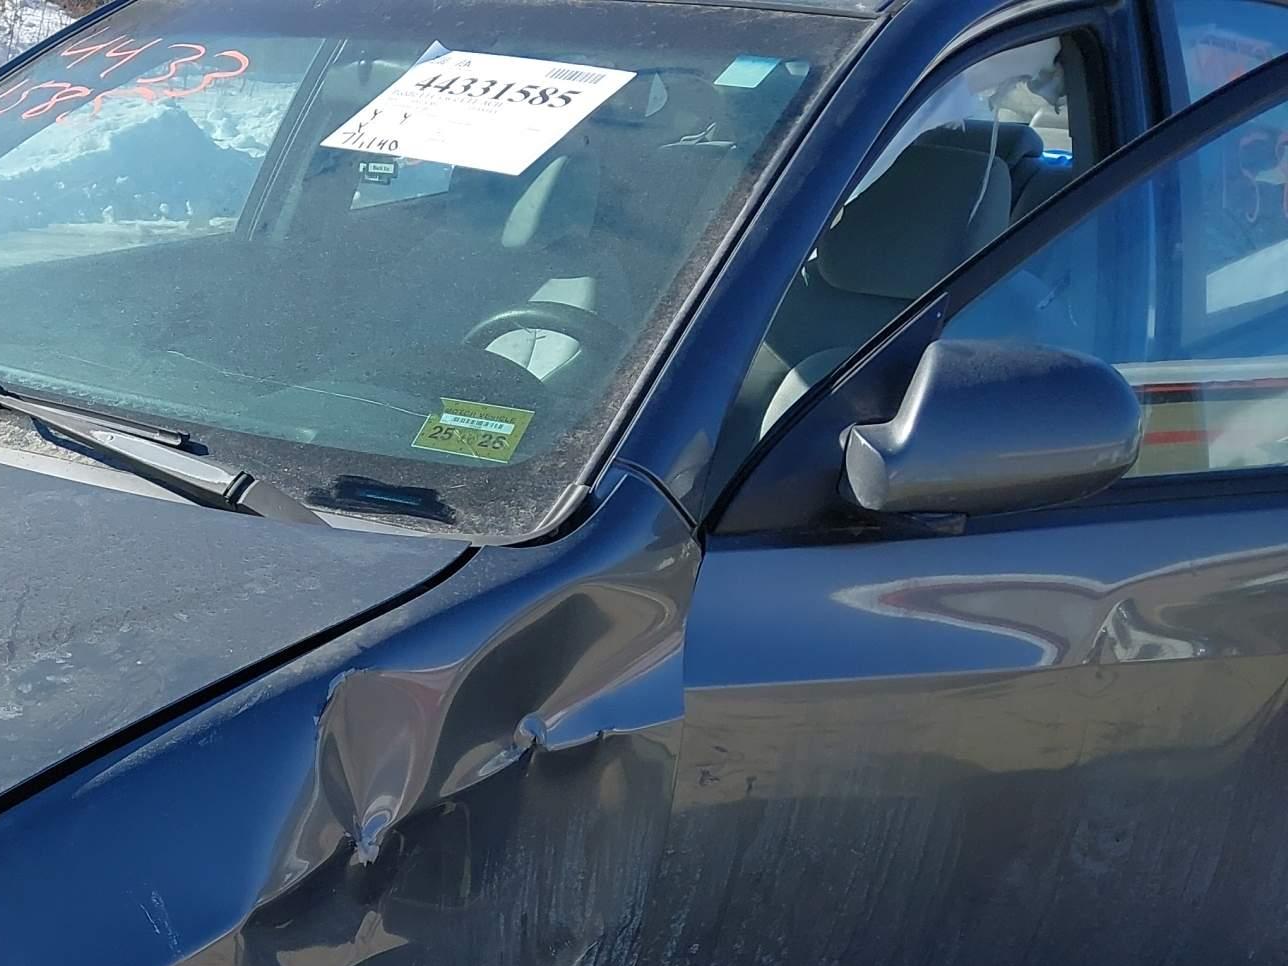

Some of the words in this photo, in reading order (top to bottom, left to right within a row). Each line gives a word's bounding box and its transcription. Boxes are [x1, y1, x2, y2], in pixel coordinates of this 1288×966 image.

[61, 26, 249, 98] 4433
[415, 74, 583, 109] 44331585
[428, 425, 455, 441] 25
[477, 433, 507, 450] 26
